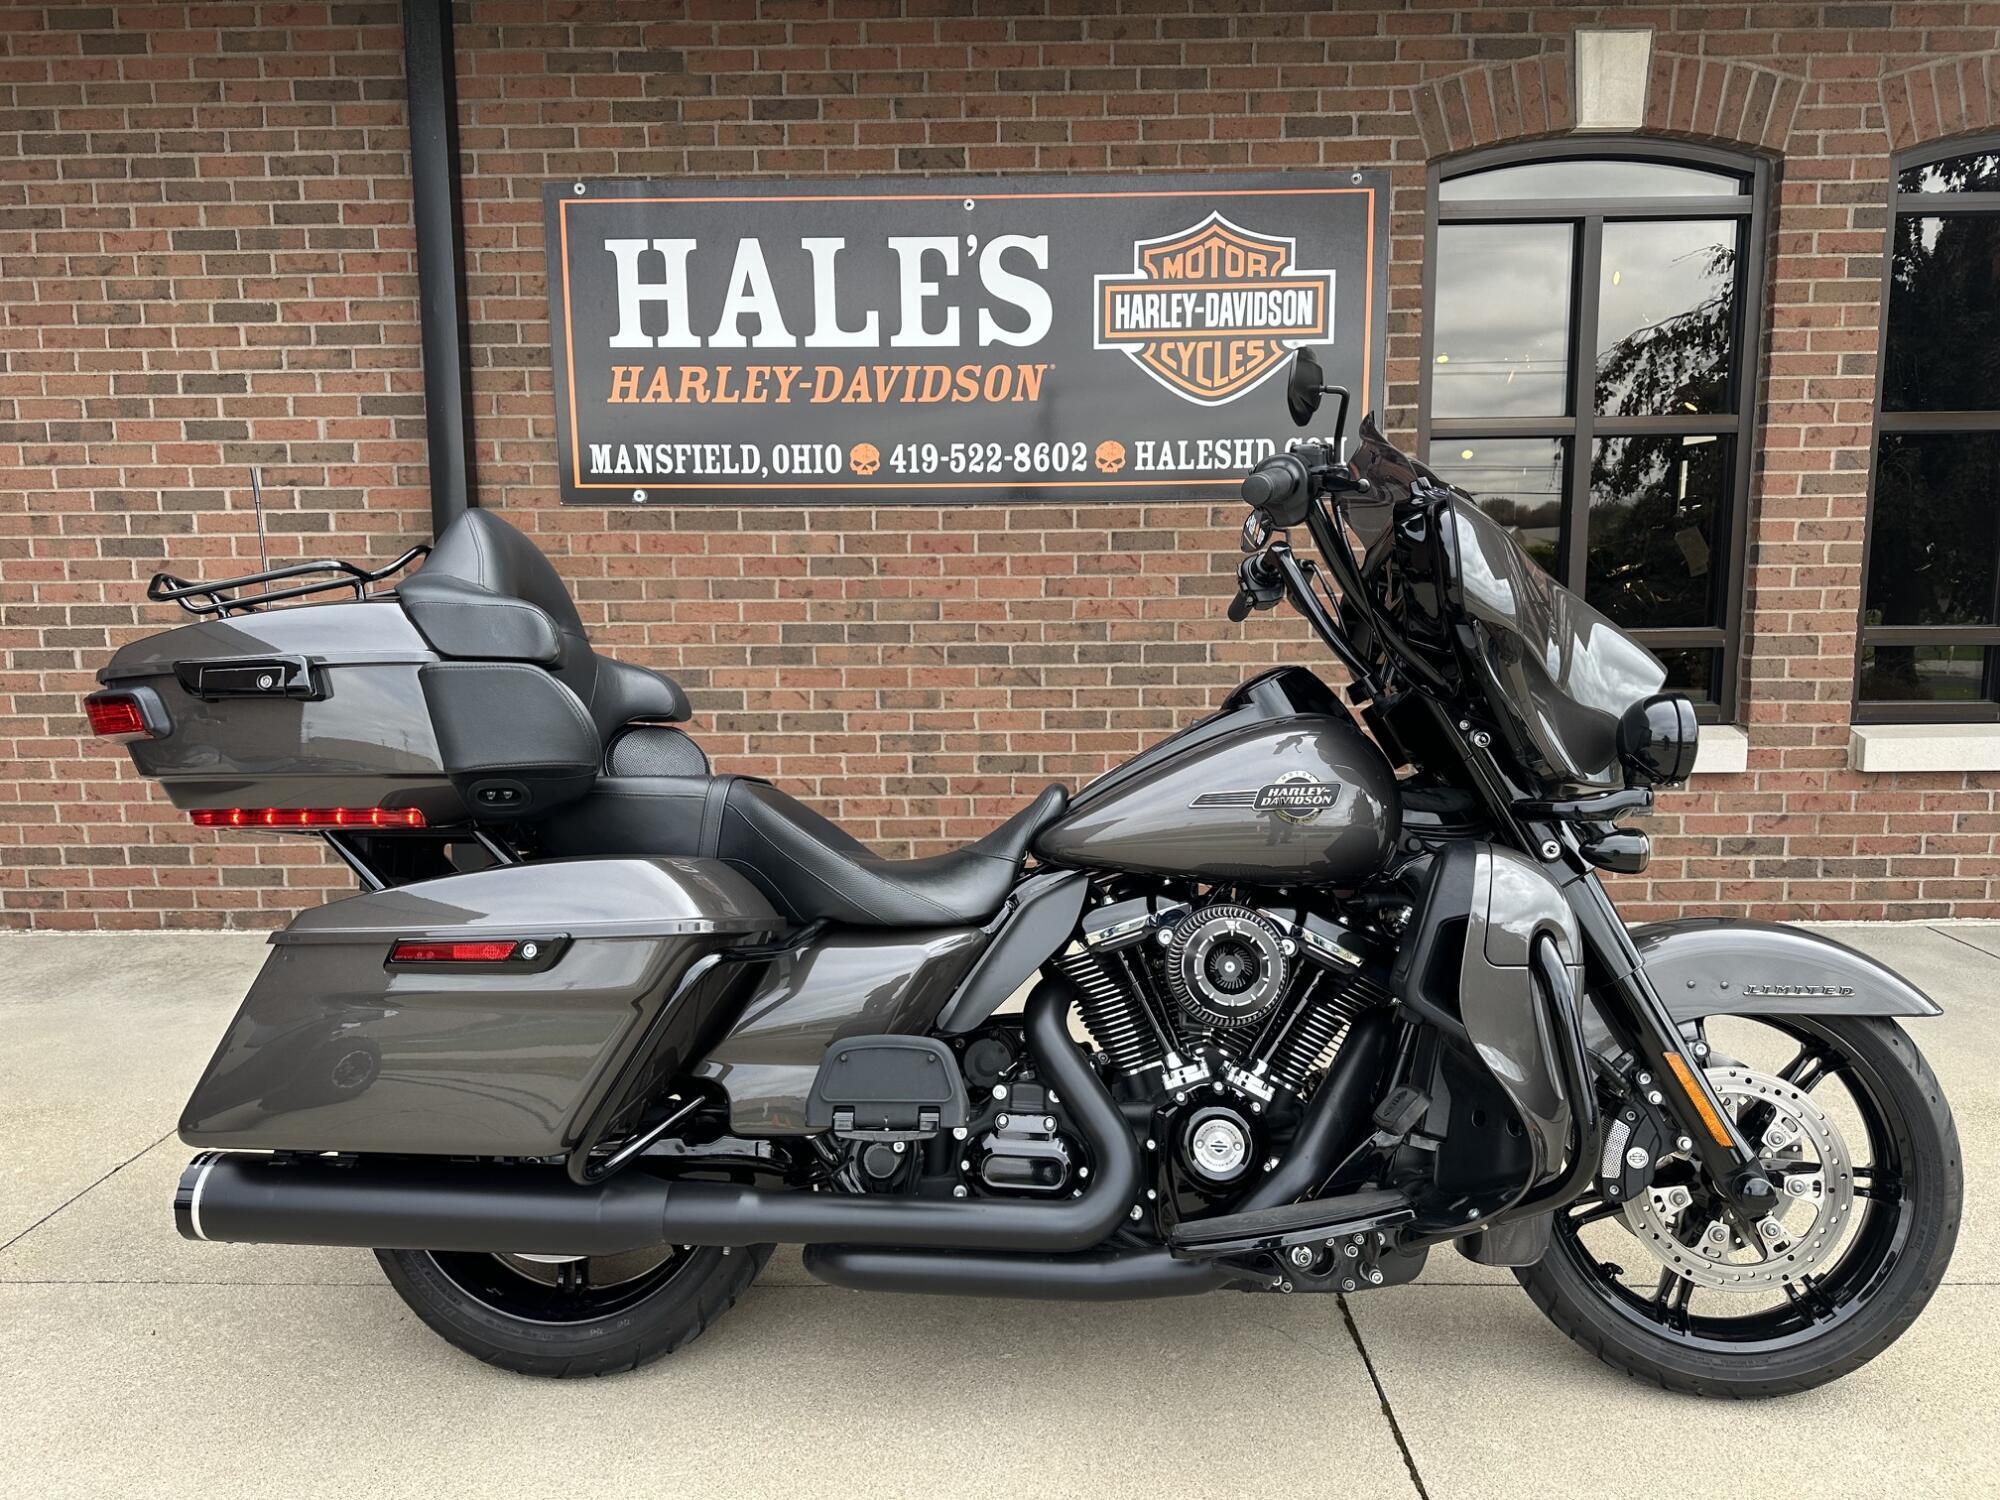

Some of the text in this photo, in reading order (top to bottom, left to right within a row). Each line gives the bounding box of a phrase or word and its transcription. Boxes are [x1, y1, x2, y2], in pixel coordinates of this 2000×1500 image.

[1162, 236, 1267, 280] MOTOR
[604, 234, 1053, 348] HALE'S
[1114, 289, 1313, 331] HARLEY-DAVIDSON
[1160, 339, 1265, 388] CYCLES
[607, 364, 1047, 404] HARLEY-DAVIDSON
[889, 441, 1088, 473] 419-522-8602
[1260, 795, 1333, 806] DAVIDSON
[1267, 786, 1332, 797] HARLEY-
[1747, 984, 1854, 995] LIMITED
